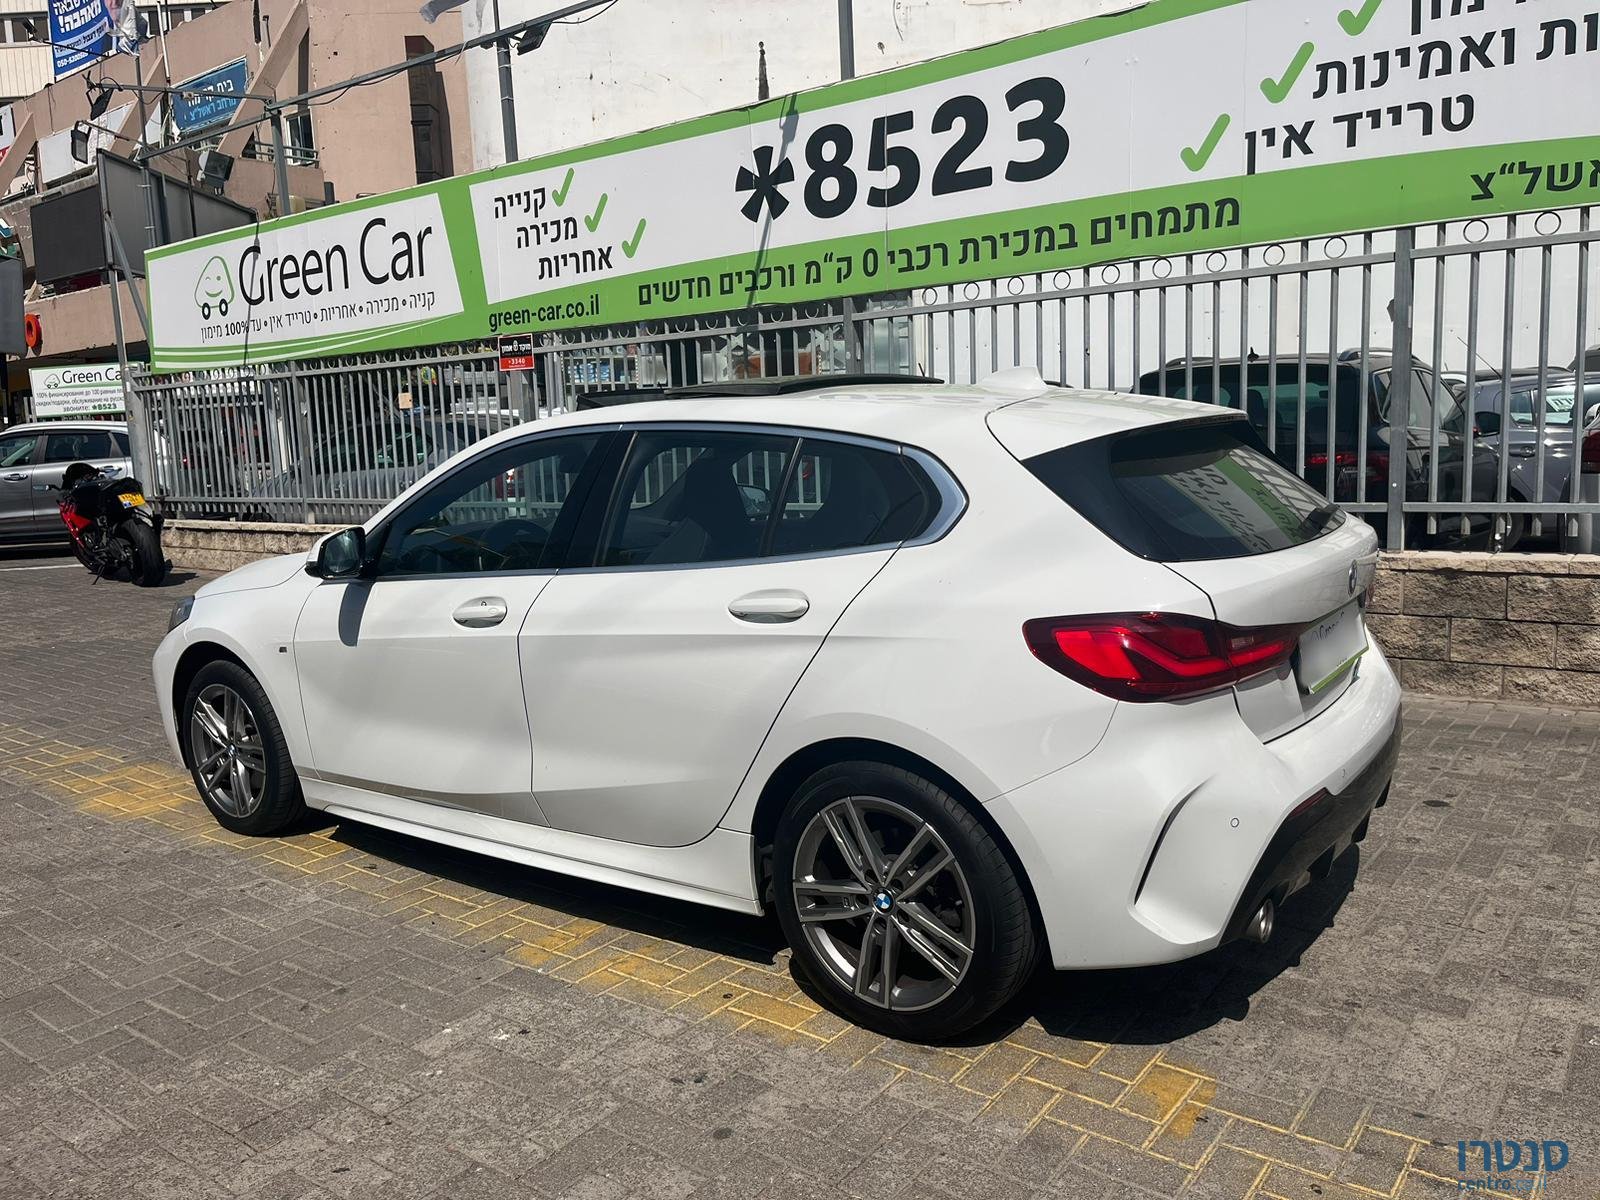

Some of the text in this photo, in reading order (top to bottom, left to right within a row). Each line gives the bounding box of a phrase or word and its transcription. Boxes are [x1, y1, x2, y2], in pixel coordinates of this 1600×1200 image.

[1535, 12, 1600, 61] ות
[1312, 27, 1515, 99] ואמינות
[216, 79, 234, 93] בית
[1244, 93, 1475, 175] טרייד אין
[1470, 159, 1600, 201] של"צ
[494, 187, 546, 219] קנייה
[517, 216, 578, 249] מכירה
[638, 197, 1240, 305] מתמחים במכירת רכבי 0 ק"מ ורכבים חדשים
[238, 217, 433, 306] Green Car
[538, 246, 613, 280] אחריות
[201, 291, 435, 343] קניה מכירה אחריות טרייד אין עד 100% מימון
[488, 293, 600, 332] green-car.co.il
[62, 367, 121, 384] Green Ca
